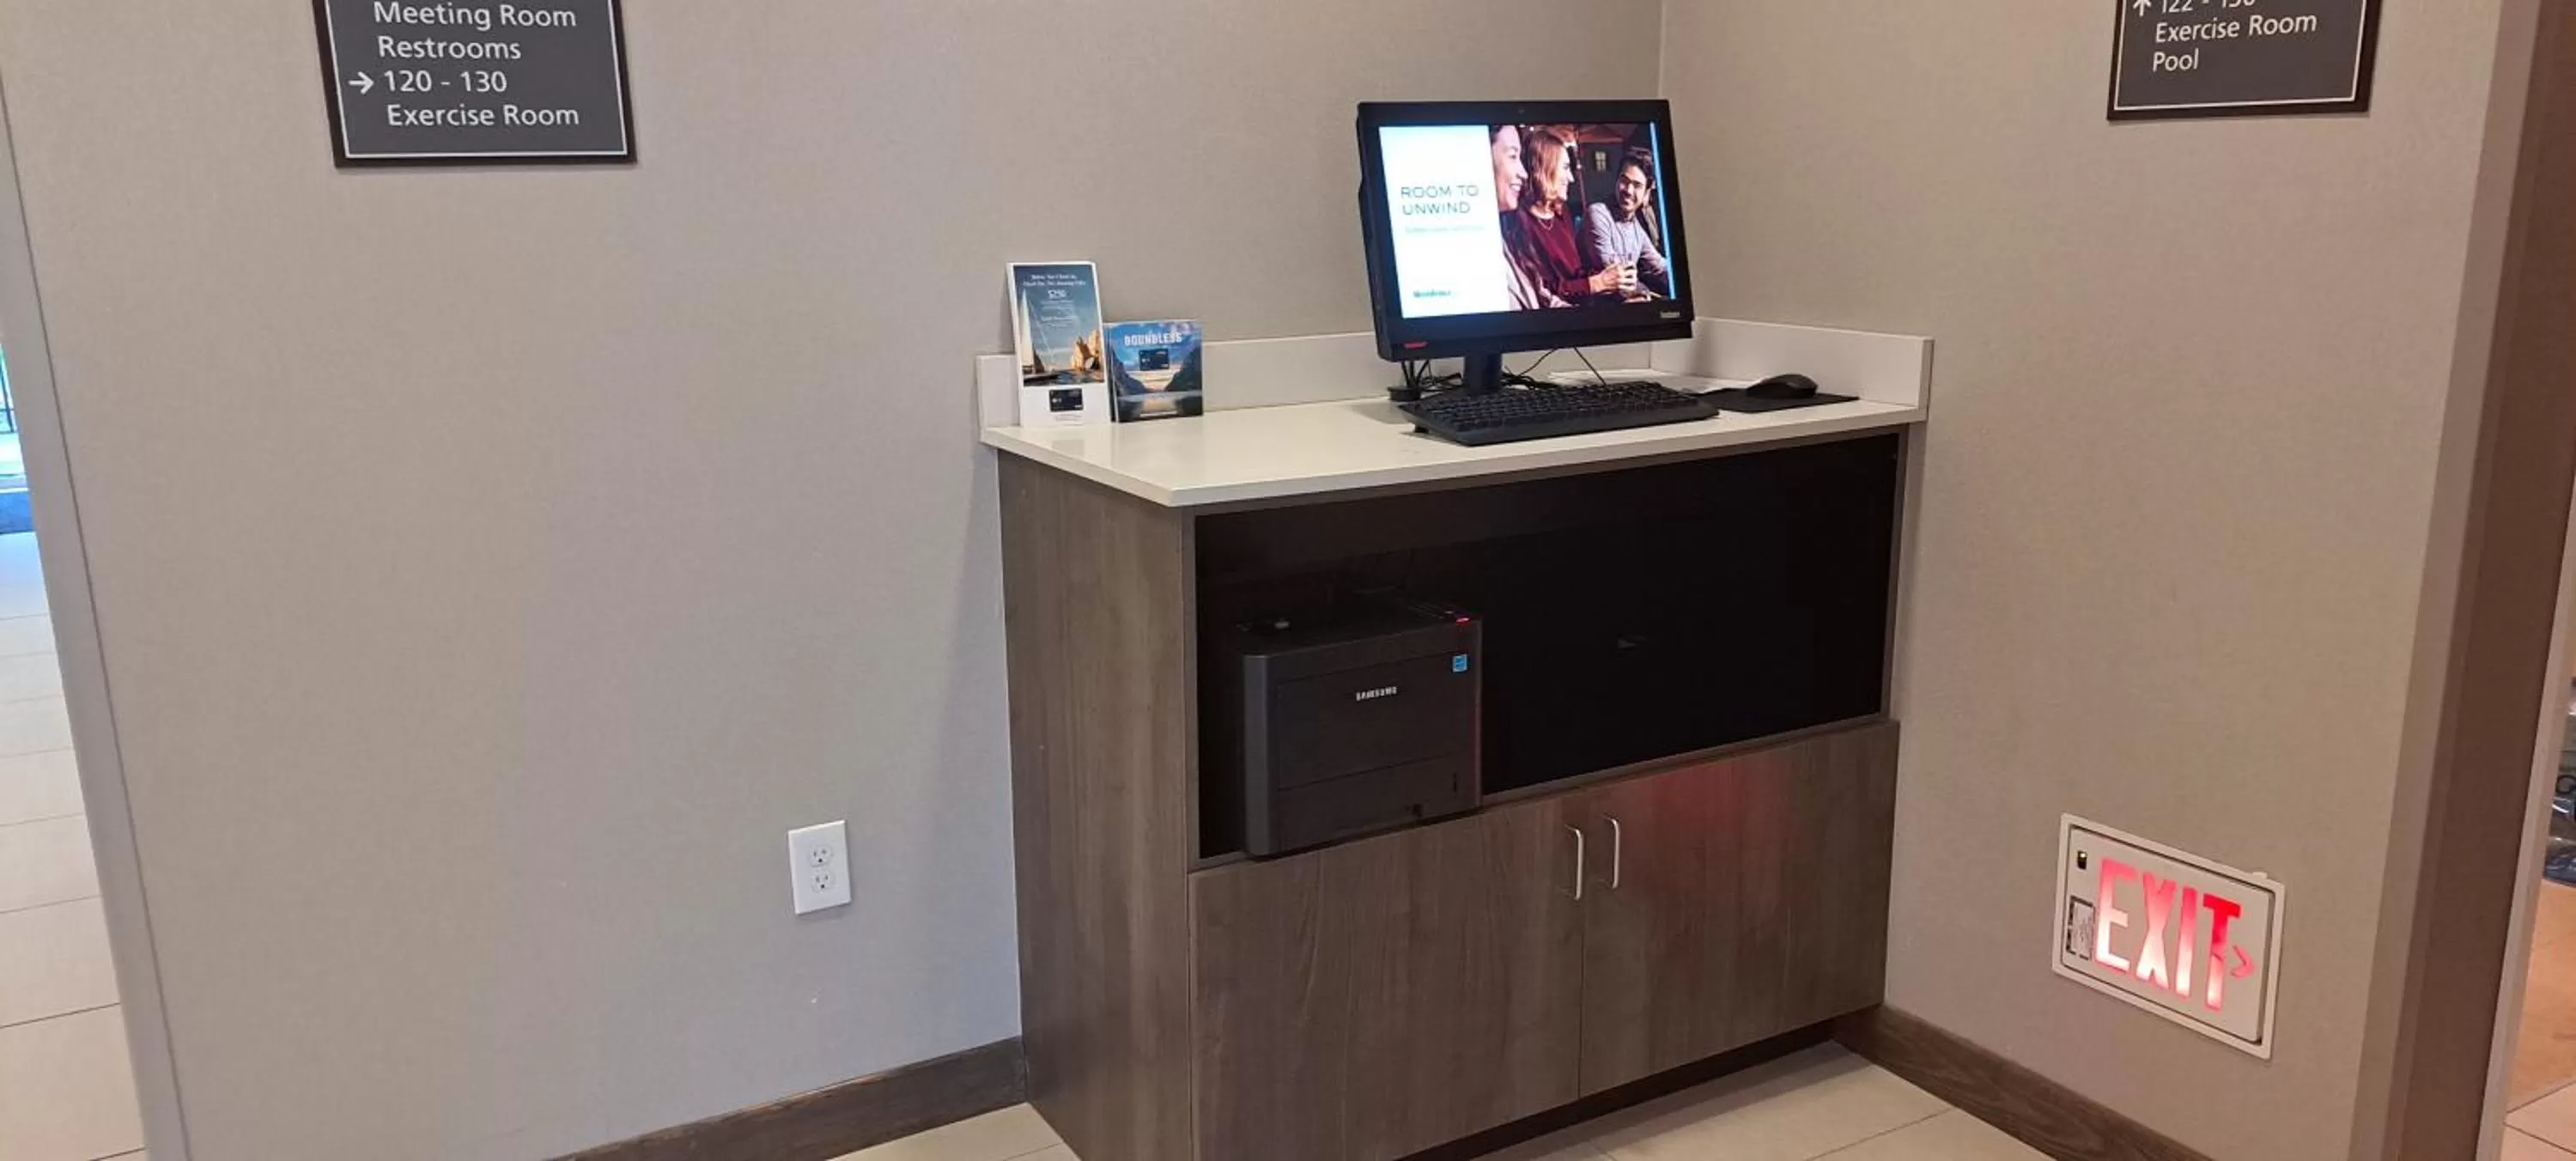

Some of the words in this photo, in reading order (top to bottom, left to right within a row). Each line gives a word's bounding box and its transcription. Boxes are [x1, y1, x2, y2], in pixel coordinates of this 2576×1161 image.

[374, 2, 491, 31] Meeting
[501, 4, 577, 27] Room
[2156, 17, 2240, 43] Exercise
[2248, 14, 2318, 36] Room
[378, 35, 522, 60] Restrooms
[2153, 48, 2200, 72] Pool
[384, 70, 433, 93] 120
[460, 70, 508, 93] 130
[387, 103, 495, 126] Exercise
[503, 105, 580, 126] Room
[1400, 185, 1452, 198] ROOM
[1456, 184, 1479, 197] TO
[1402, 201, 1471, 216] UNWIND
[1124, 332, 1182, 346] BOUNDLESS
[1356, 686, 1397, 701] SAMSUNG
[2096, 858, 2241, 1010] EXIT
